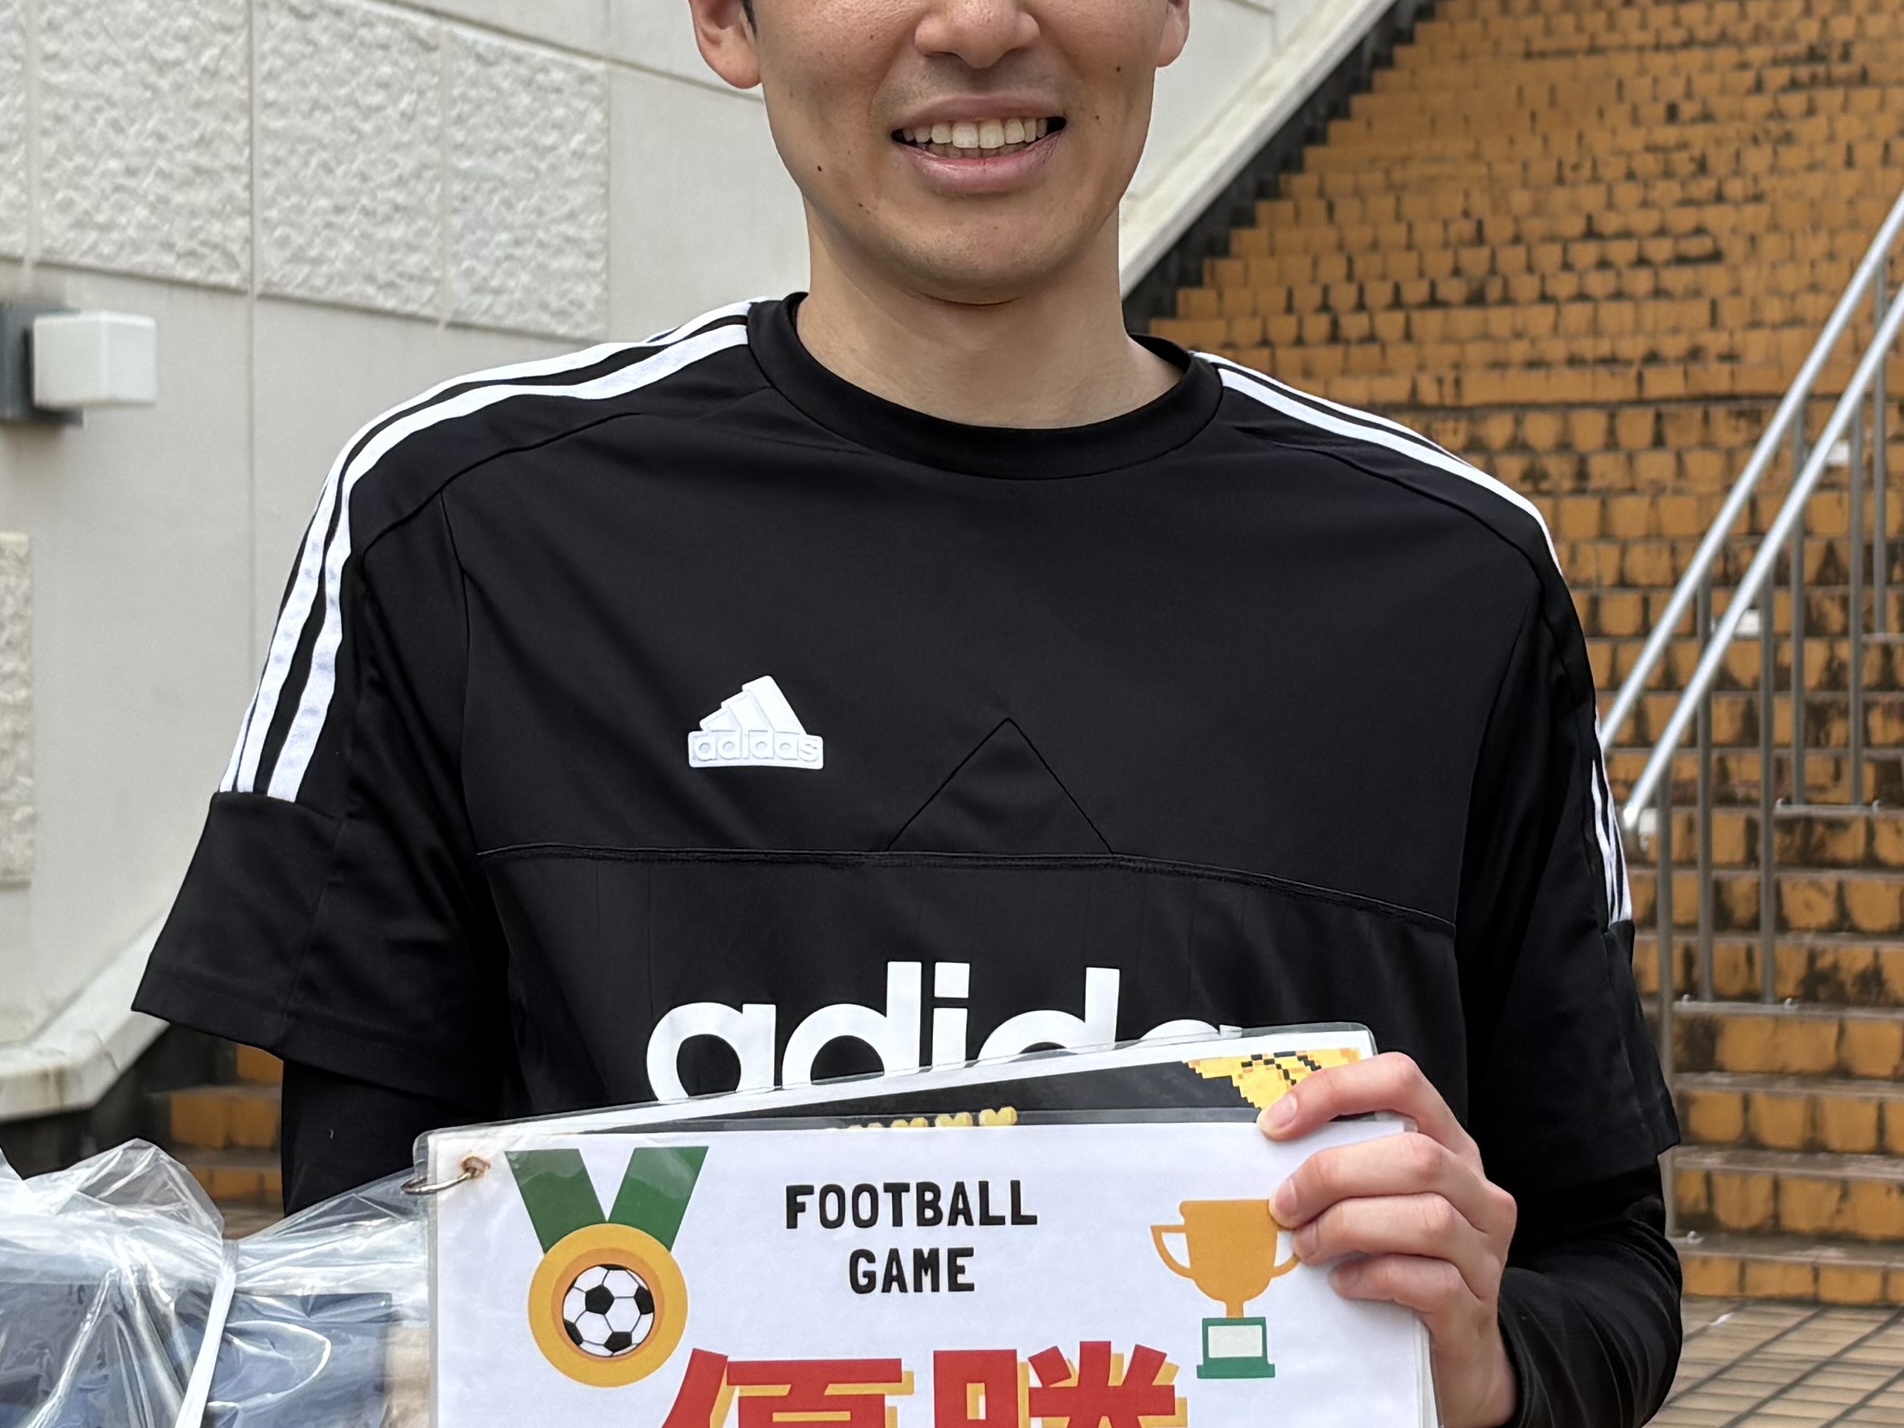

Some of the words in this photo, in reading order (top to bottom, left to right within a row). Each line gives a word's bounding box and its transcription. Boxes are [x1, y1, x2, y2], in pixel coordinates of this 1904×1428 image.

[694, 730, 819, 763] adidas
[647, 961, 1243, 1104] adid
[785, 1180, 1039, 1229] FOOTBALL
[848, 1247, 976, 1294] GAME
